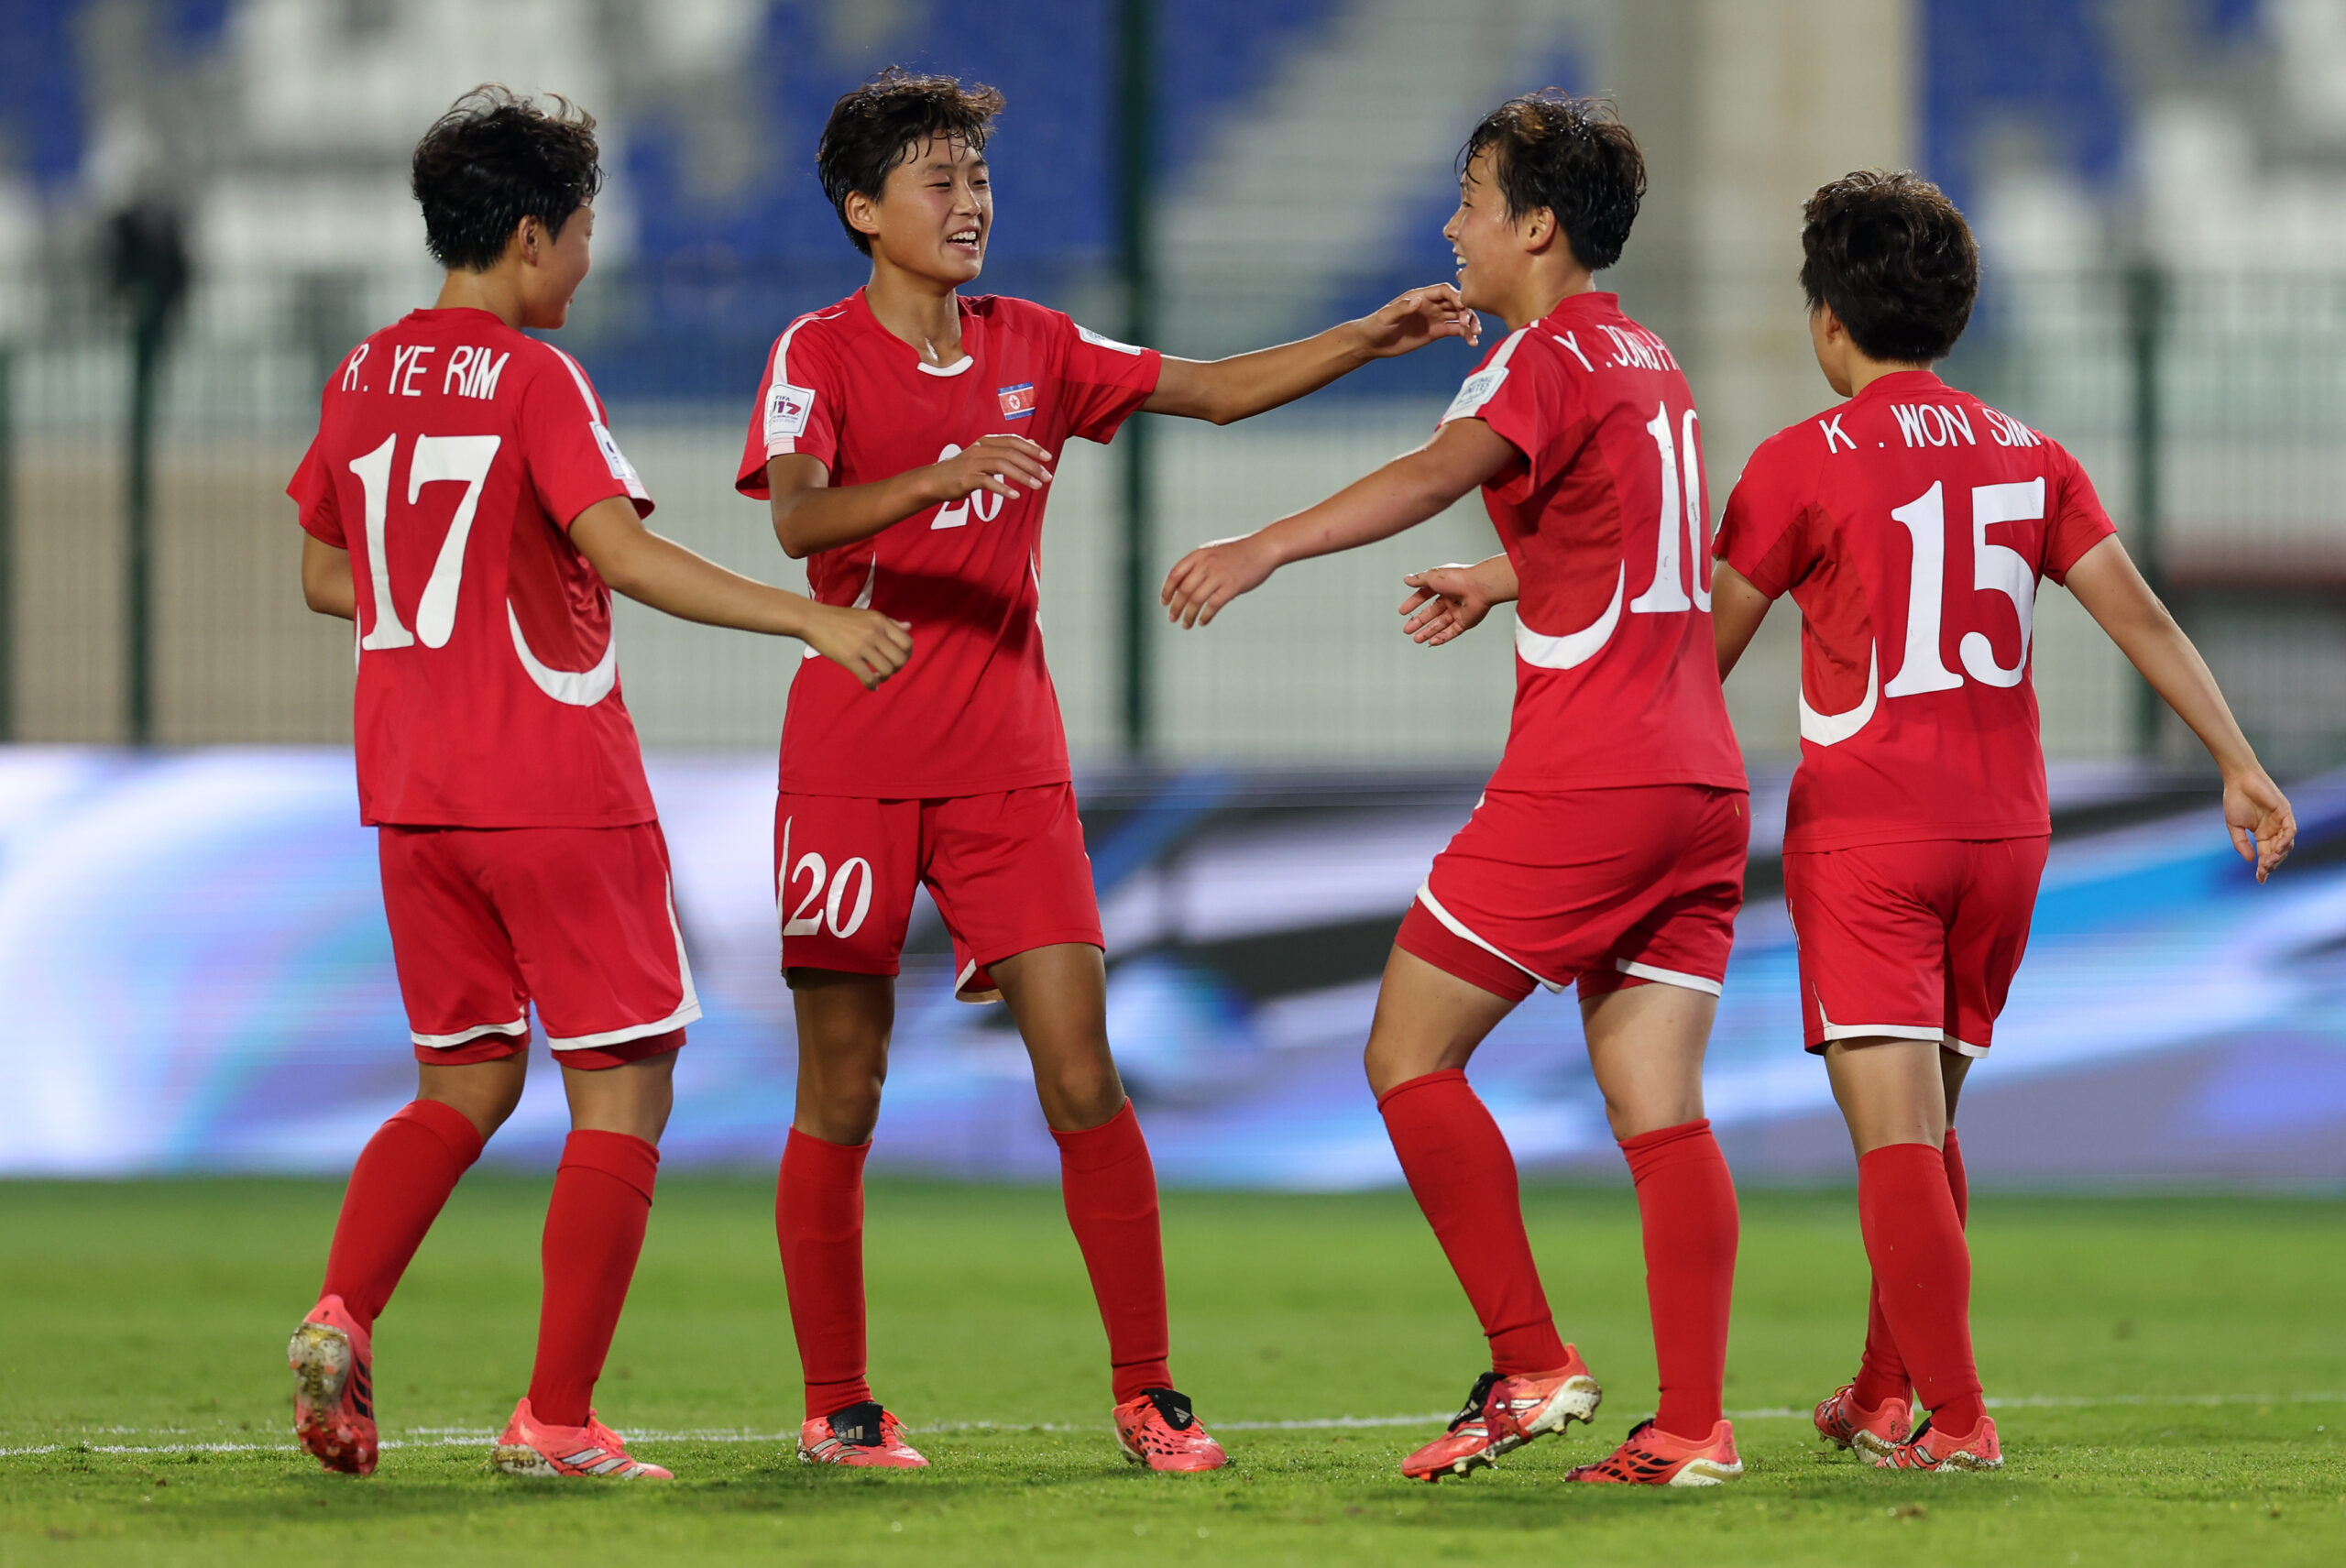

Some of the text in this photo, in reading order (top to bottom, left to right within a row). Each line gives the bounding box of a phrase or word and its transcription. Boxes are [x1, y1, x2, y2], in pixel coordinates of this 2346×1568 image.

[342, 343, 510, 400] R. YE RIM
[1890, 403, 1977, 448] WON
[1982, 407, 2042, 448] SIM
[348, 433, 502, 652] 17
[1884, 476, 2046, 698] 15
[783, 851, 873, 939] 20
